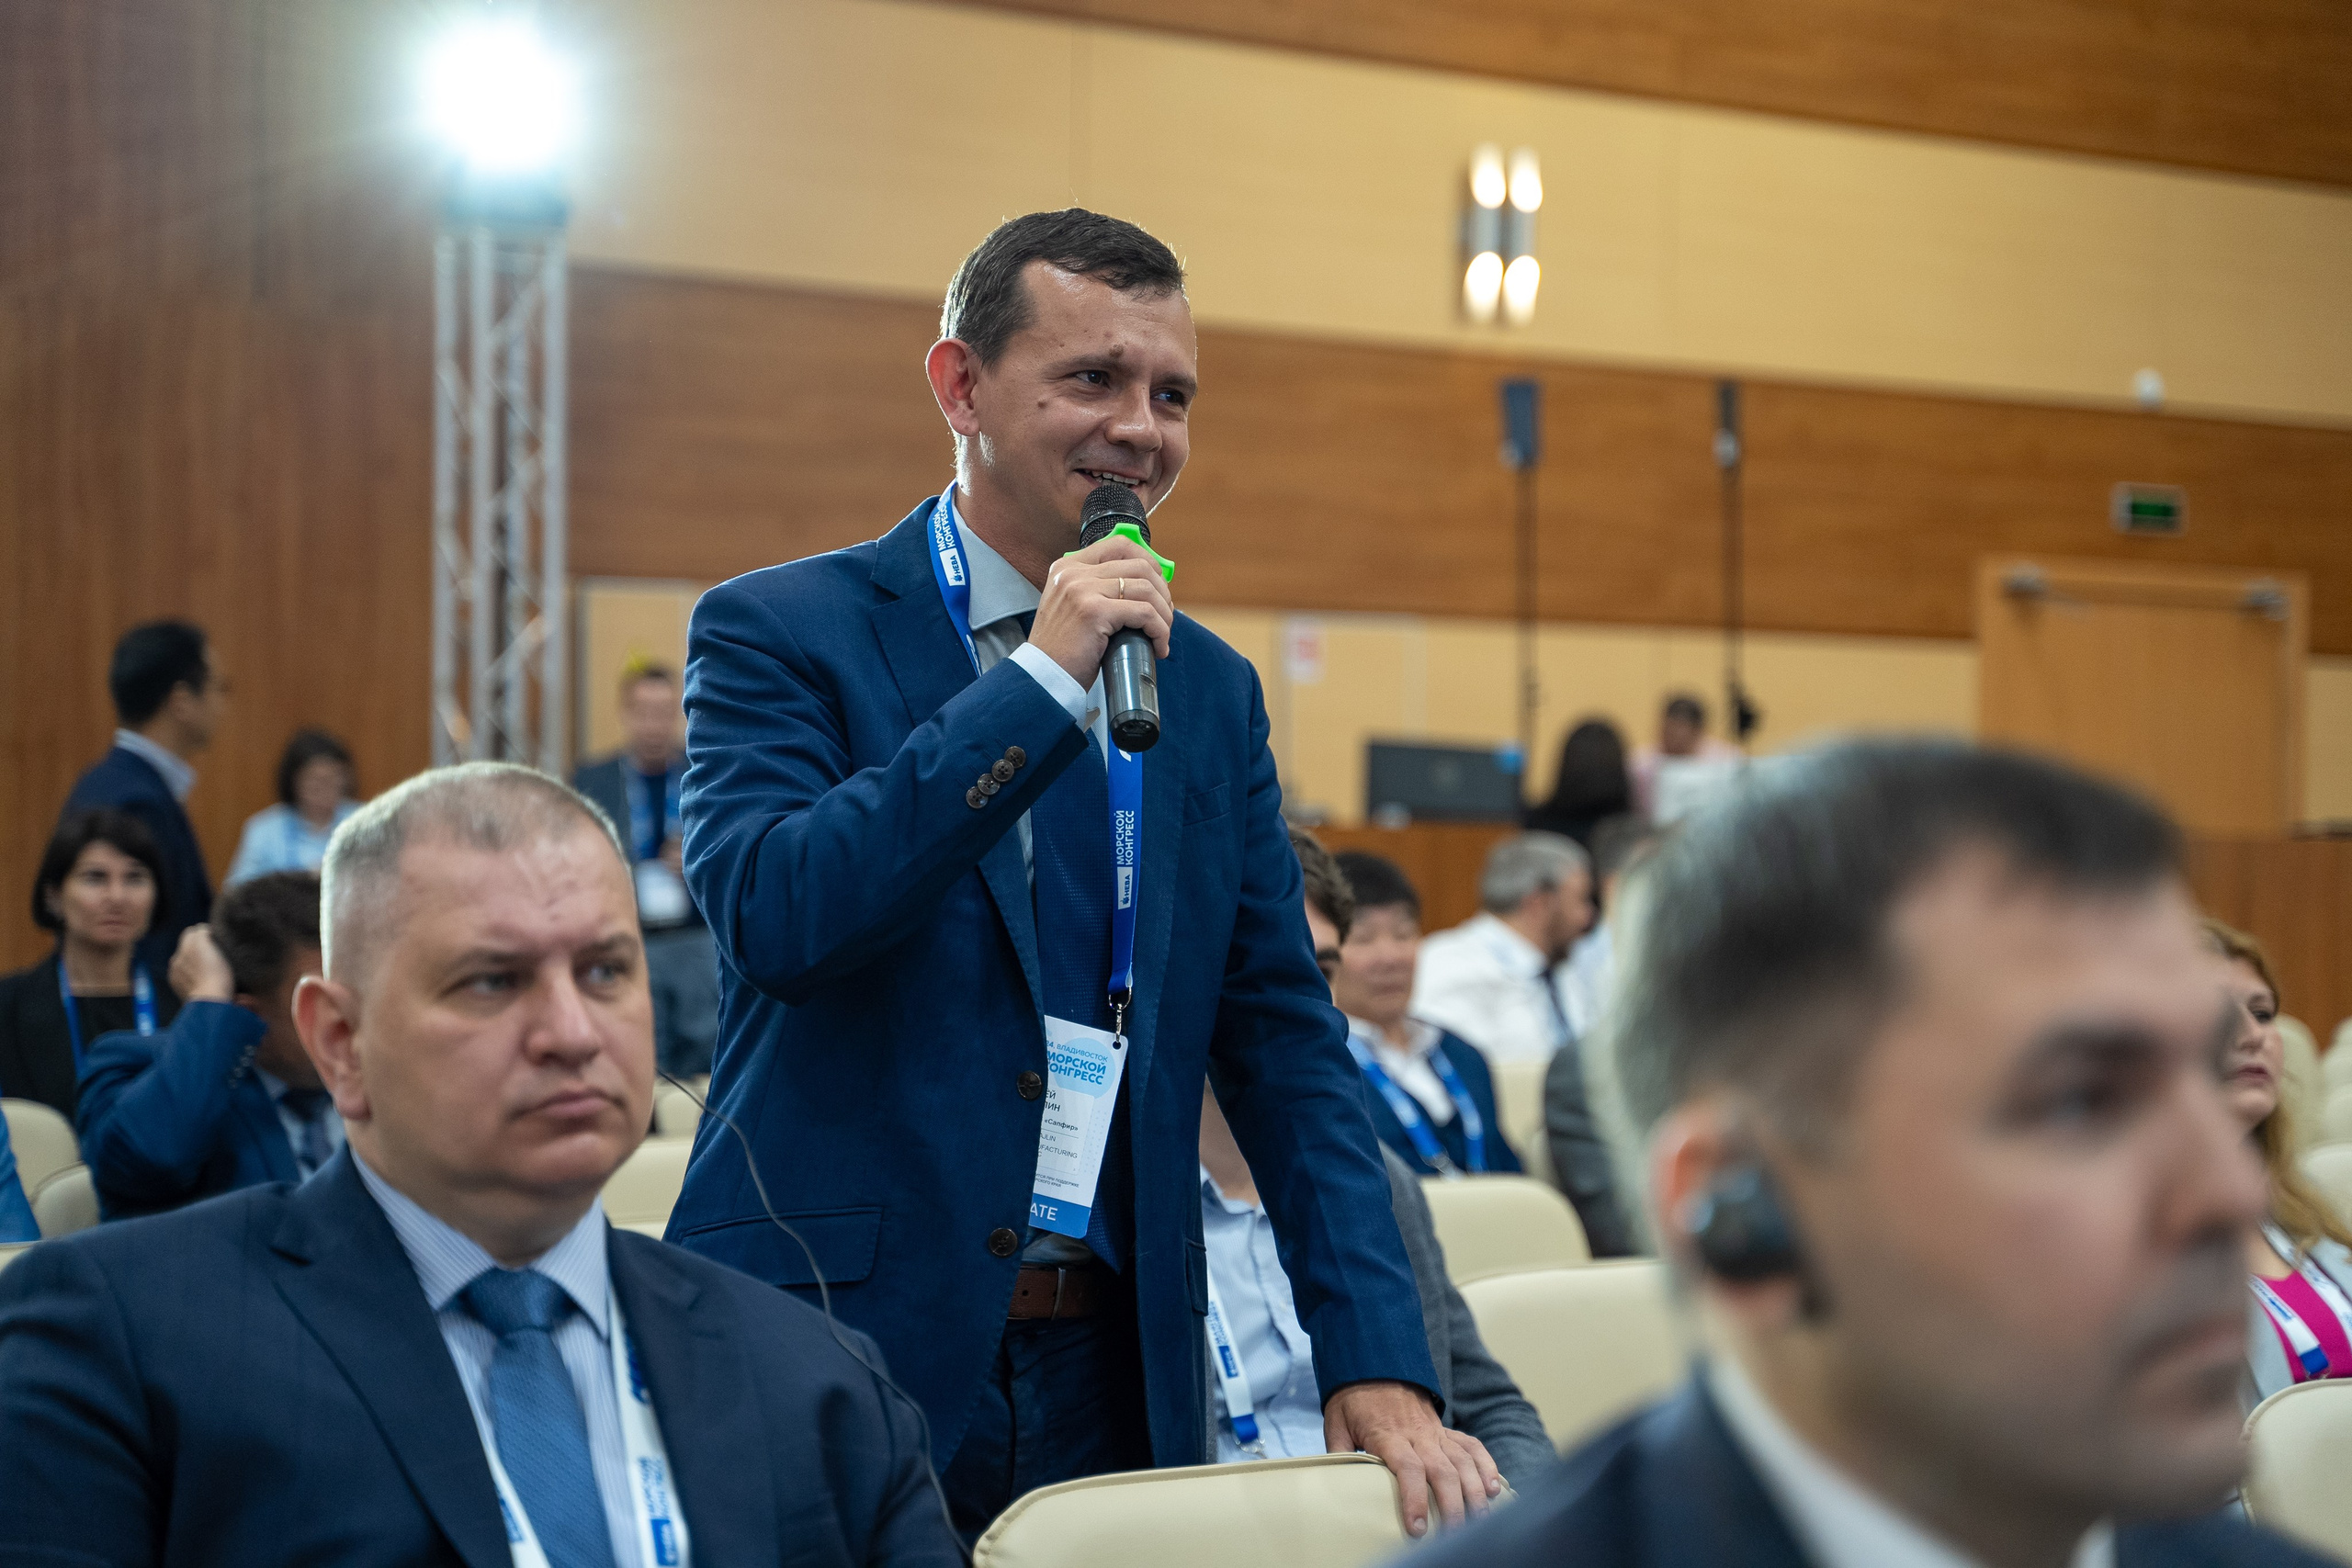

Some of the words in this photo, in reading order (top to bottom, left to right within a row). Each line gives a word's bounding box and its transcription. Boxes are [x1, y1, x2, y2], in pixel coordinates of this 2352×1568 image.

[933, 511, 946, 551] МОРСКОЙ
[940, 505, 956, 548] КОНГРЕСС
[950, 555, 961, 574] НЕВА
[1114, 810, 1125, 865] МОРСКОЙ
[1125, 810, 1135, 865] КОНГРЕСС
[1047, 1051, 1106, 1075] МОРСКОЙ
[1057, 1043, 1108, 1062] ВЛАДИВОСТОК
[1048, 1062, 1103, 1085] ОНГРЕСС
[1045, 1118, 1078, 1131] «Сапфир»
[1030, 1202, 1057, 1221] ATE
